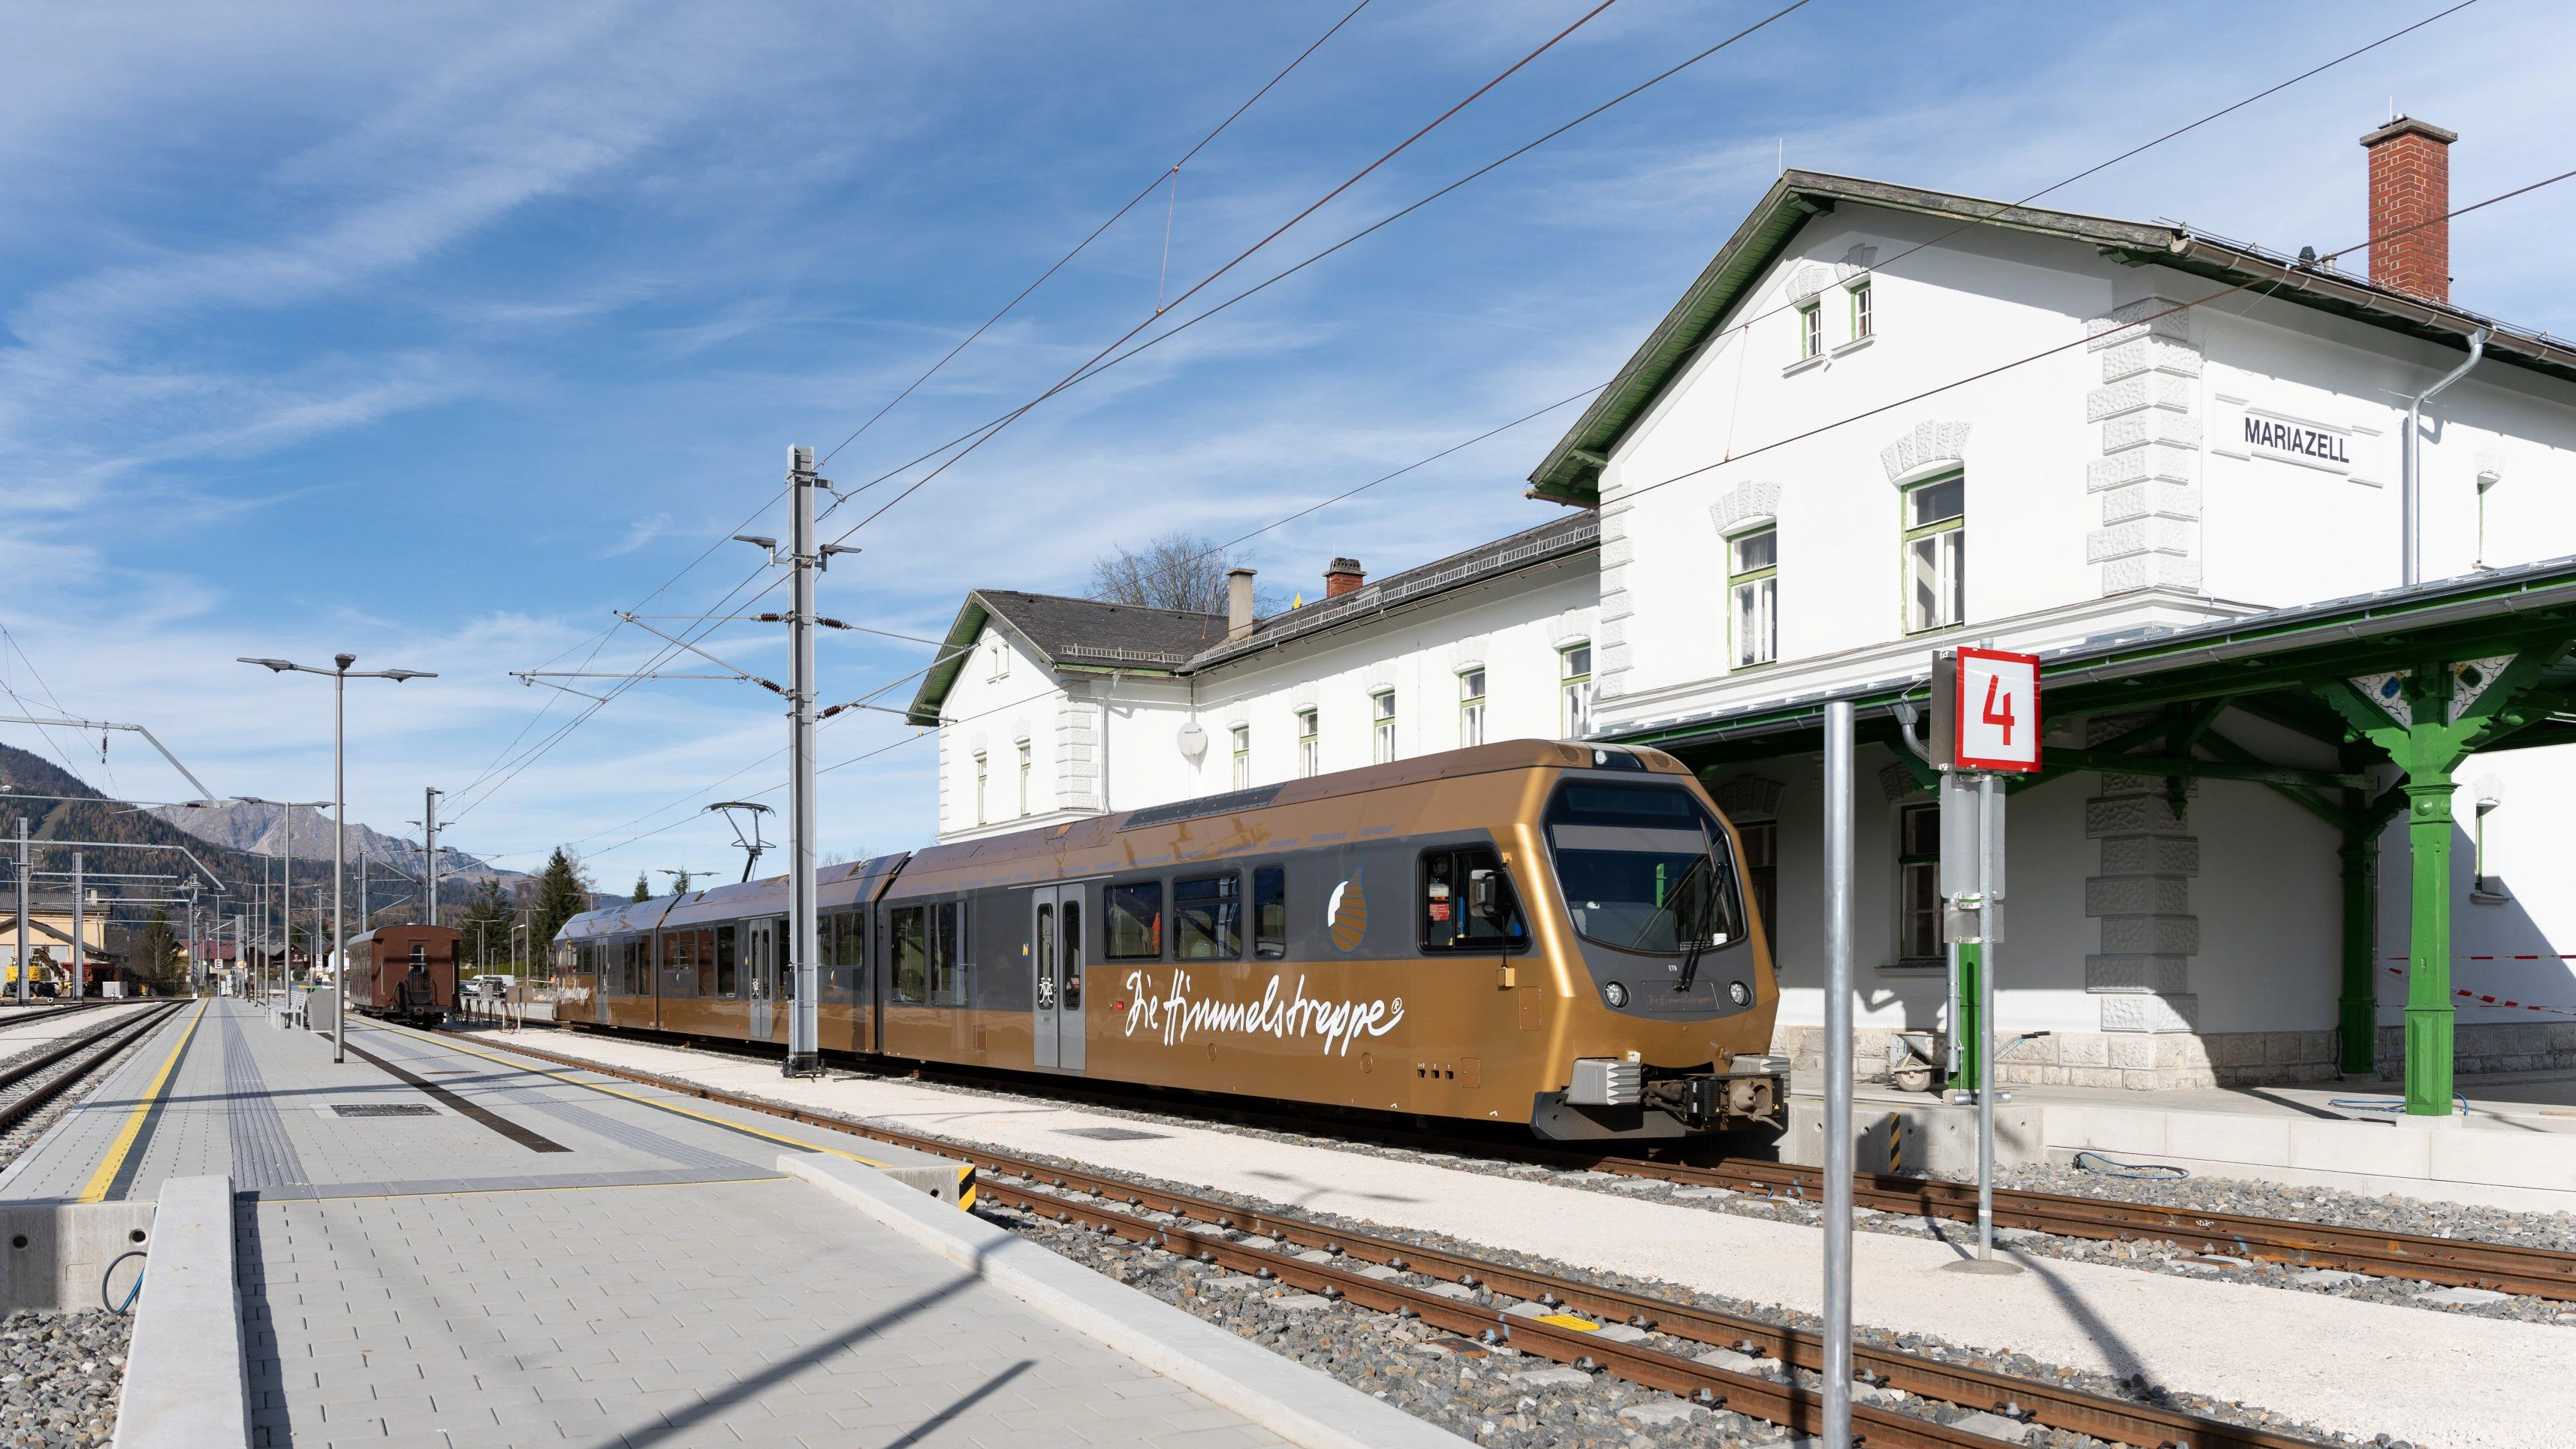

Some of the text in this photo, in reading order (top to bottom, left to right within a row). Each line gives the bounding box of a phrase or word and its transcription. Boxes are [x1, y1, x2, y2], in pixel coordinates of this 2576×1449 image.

[2245, 417, 2349, 463] MARIAZELL
[1983, 675, 2015, 745] 4
[1126, 969, 1158, 1037] Die
